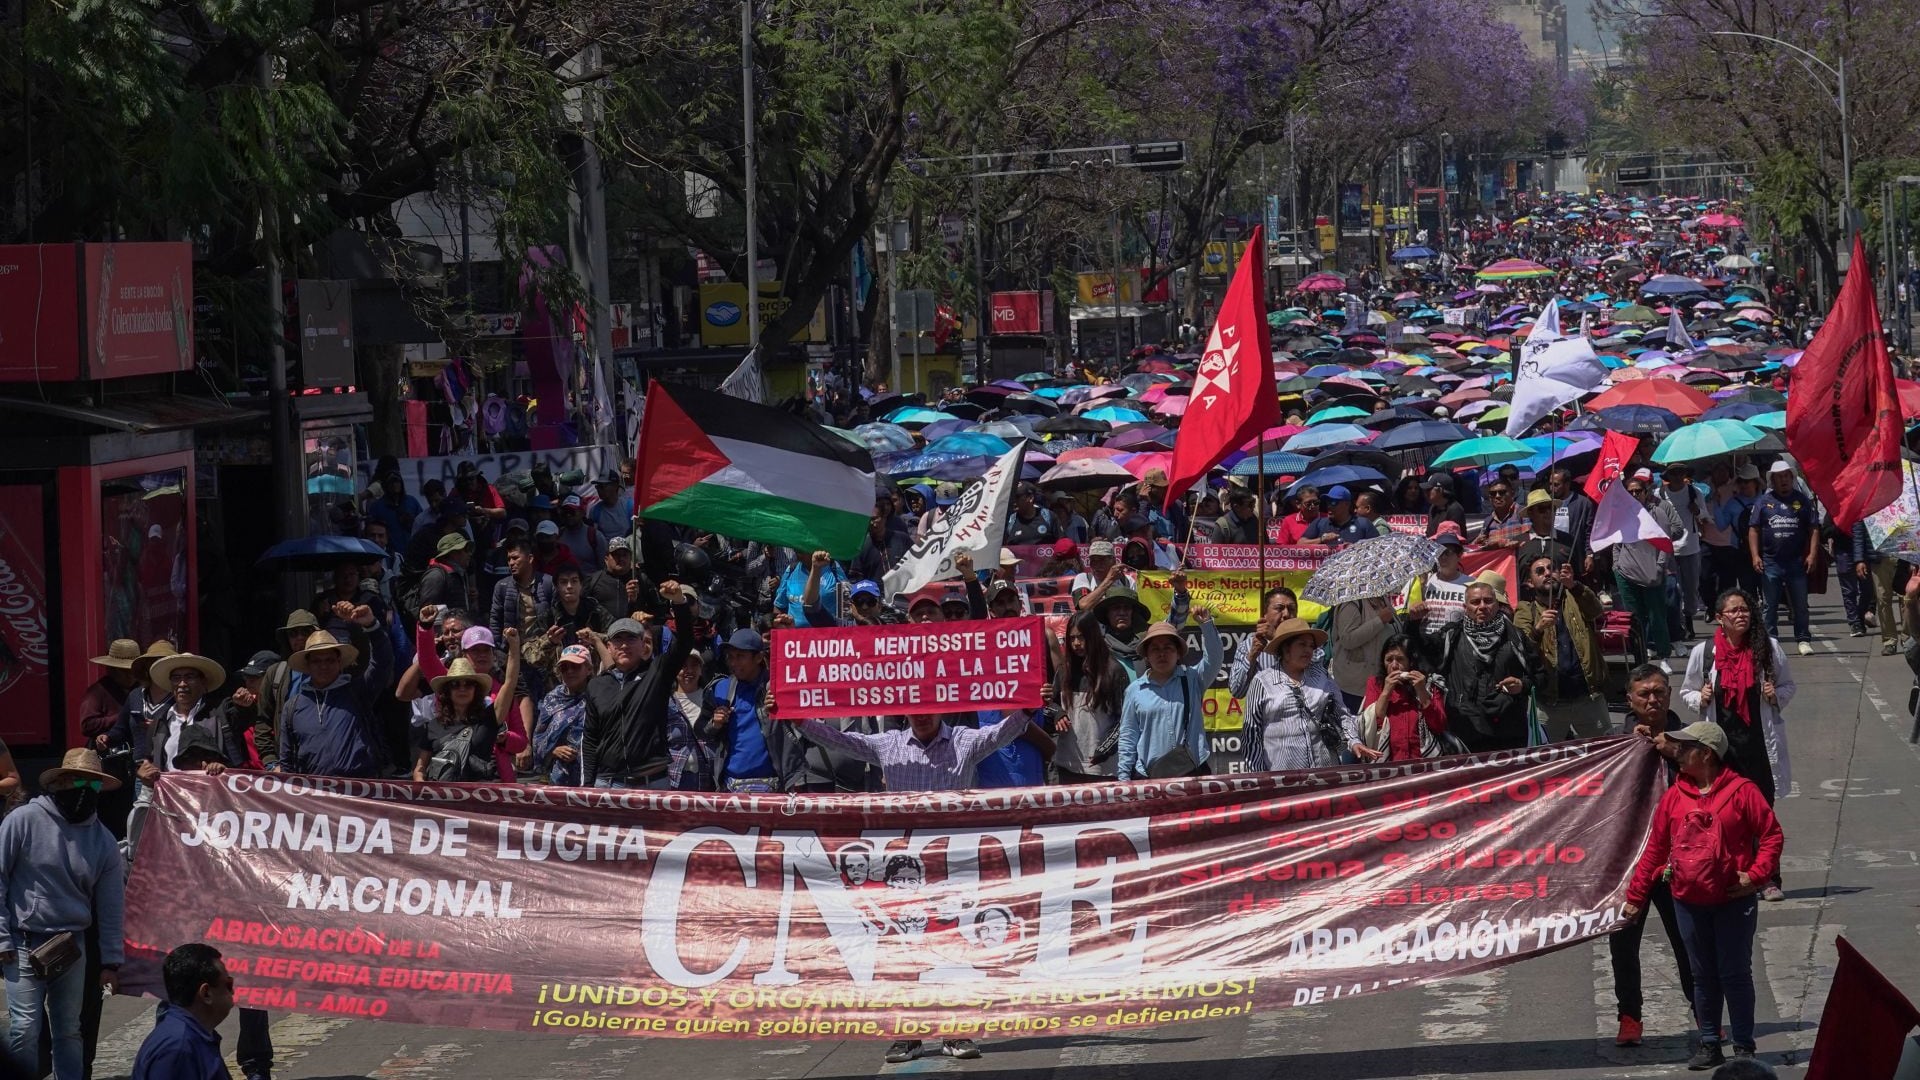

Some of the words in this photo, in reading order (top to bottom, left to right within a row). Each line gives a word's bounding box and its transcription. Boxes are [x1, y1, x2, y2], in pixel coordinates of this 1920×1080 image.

[155, 304, 172, 331] todas
[1205, 558, 1295, 569] TRABAJAORES
[1298, 559, 1313, 569] DE
[1222, 546, 1311, 558] TRABAADORES
[1142, 577, 1216, 591] Asalea
[784, 639, 861, 660] CLAUDIA,
[874, 632, 986, 656] MENTISSSTE
[996, 629, 1031, 649] CON
[785, 665, 808, 684] LA
[817, 656, 924, 683] ABROGACIÓN
[936, 660, 947, 677] A
[959, 657, 983, 677] LA
[995, 654, 1030, 674] LEY
[800, 689, 835, 708] DEL
[850, 685, 921, 706] ISSSTE
[936, 683, 959, 702] DE
[970, 680, 1019, 700] 2007
[227, 773, 552, 807] COORDINADORA
[565, 791, 775, 814] NACIONAL
[797, 795, 847, 815] DE
[862, 781, 1188, 816] TRABAJADORES
[1198, 777, 1260, 796] DE
[1271, 772, 1328, 789] LA
[1338, 743, 1591, 784] EDUCACIÓN
[1259, 794, 1367, 822] UMA
[1382, 790, 1430, 814] NI
[1447, 772, 1606, 804] AFORE
[181, 811, 394, 855] JORNADA
[409, 818, 468, 857] DE
[497, 821, 648, 862] LUCHA
[1267, 820, 1457, 850] Regreso
[1180, 860, 1365, 886] Sistema
[1383, 842, 1586, 873] Slidario
[286, 872, 523, 919] NACIONAL
[641, 816, 1151, 987] CNTE
[205, 918, 386, 956] ABROGACIÓN
[387, 941, 413, 958] DE
[417, 943, 441, 959] LA
[1288, 911, 1520, 964] ABROGACIÓN
[255, 956, 371, 988] REFORMA
[379, 969, 513, 996] EDUCATIVA
[538, 984, 689, 1008] ¡UNIDOS
[700, 989, 722, 1007] Y
[727, 985, 993, 1011] ORGANIZADOS,
[1008, 976, 1257, 1005] VENCEREMOS!
[233, 985, 299, 1010] PEÑA
[318, 995, 389, 1018] AMLO
[1293, 985, 1328, 1007] DE
[531, 1010, 667, 1032] ¡Gobierne
[675, 1014, 750, 1036] quien
[756, 1014, 885, 1037] gobierne,
[894, 1016, 931, 1035] los
[938, 1014, 1062, 1035] derechos
[1069, 1014, 1099, 1029] se
[1105, 1001, 1252, 1027] defienden!
